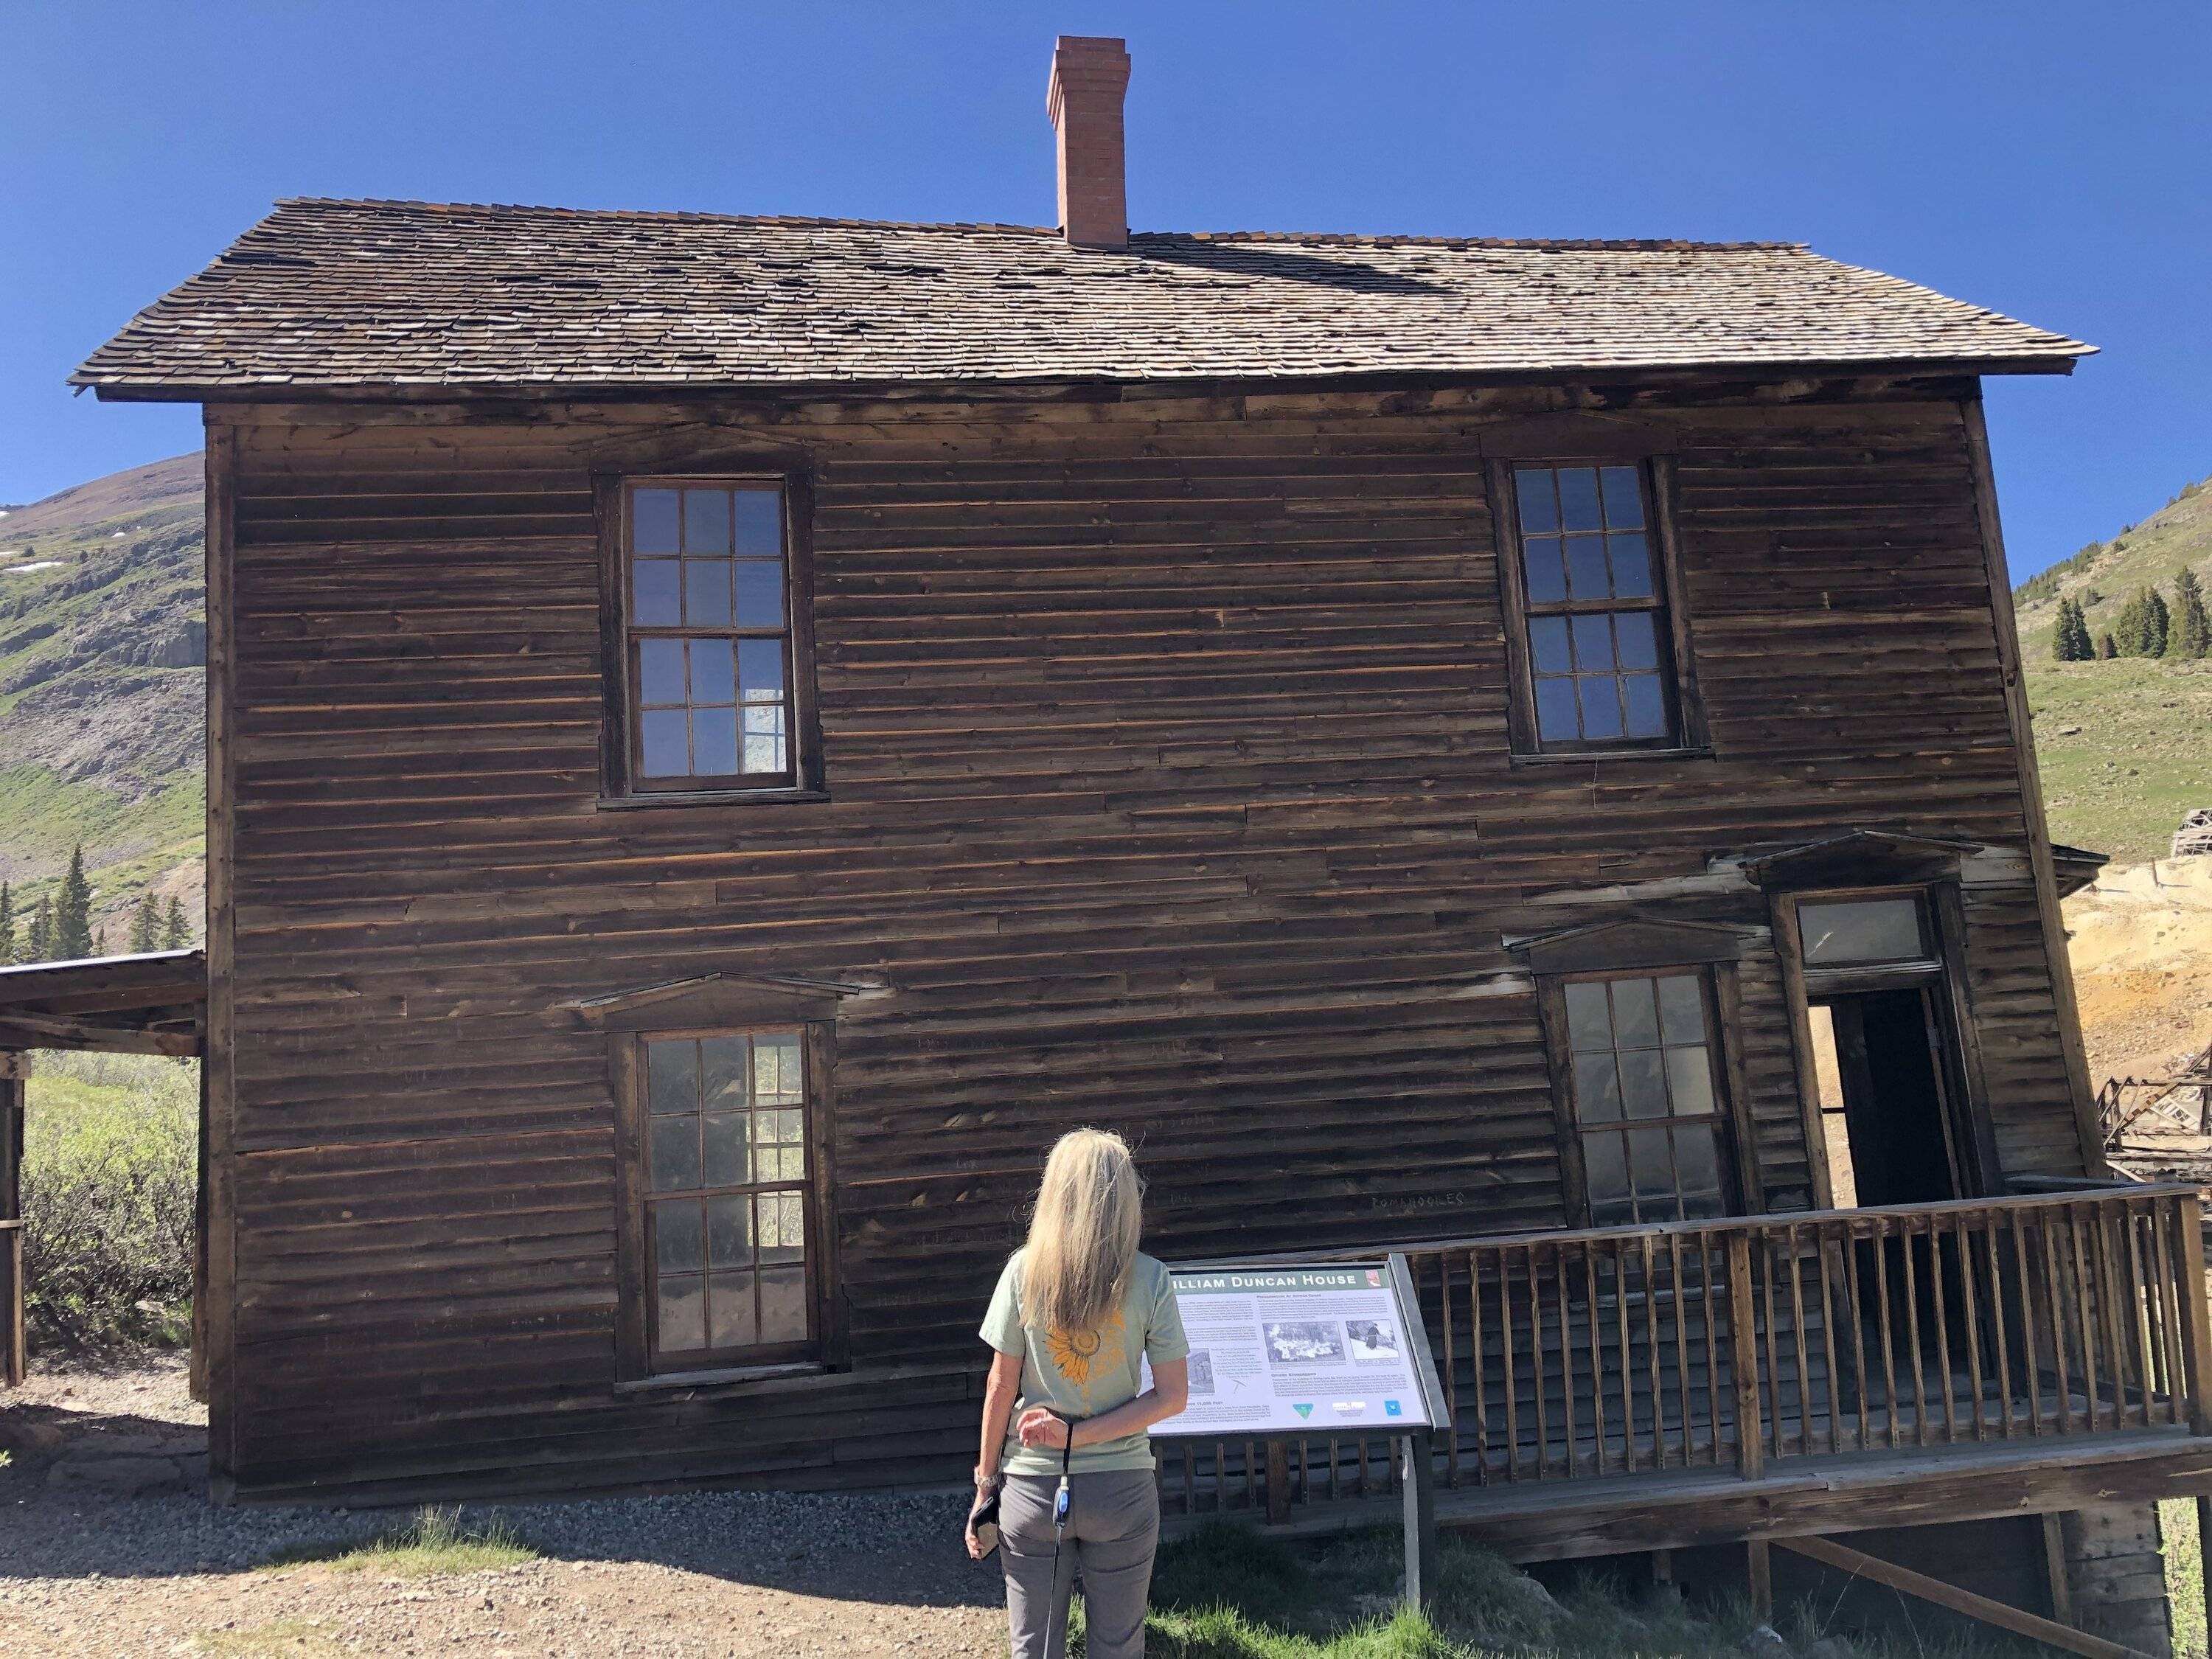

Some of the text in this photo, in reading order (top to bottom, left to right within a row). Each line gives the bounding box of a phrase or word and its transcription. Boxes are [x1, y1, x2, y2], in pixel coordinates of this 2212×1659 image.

[1172, 1273, 1357, 1290] ILLIAM DUNCAN HOUSE
